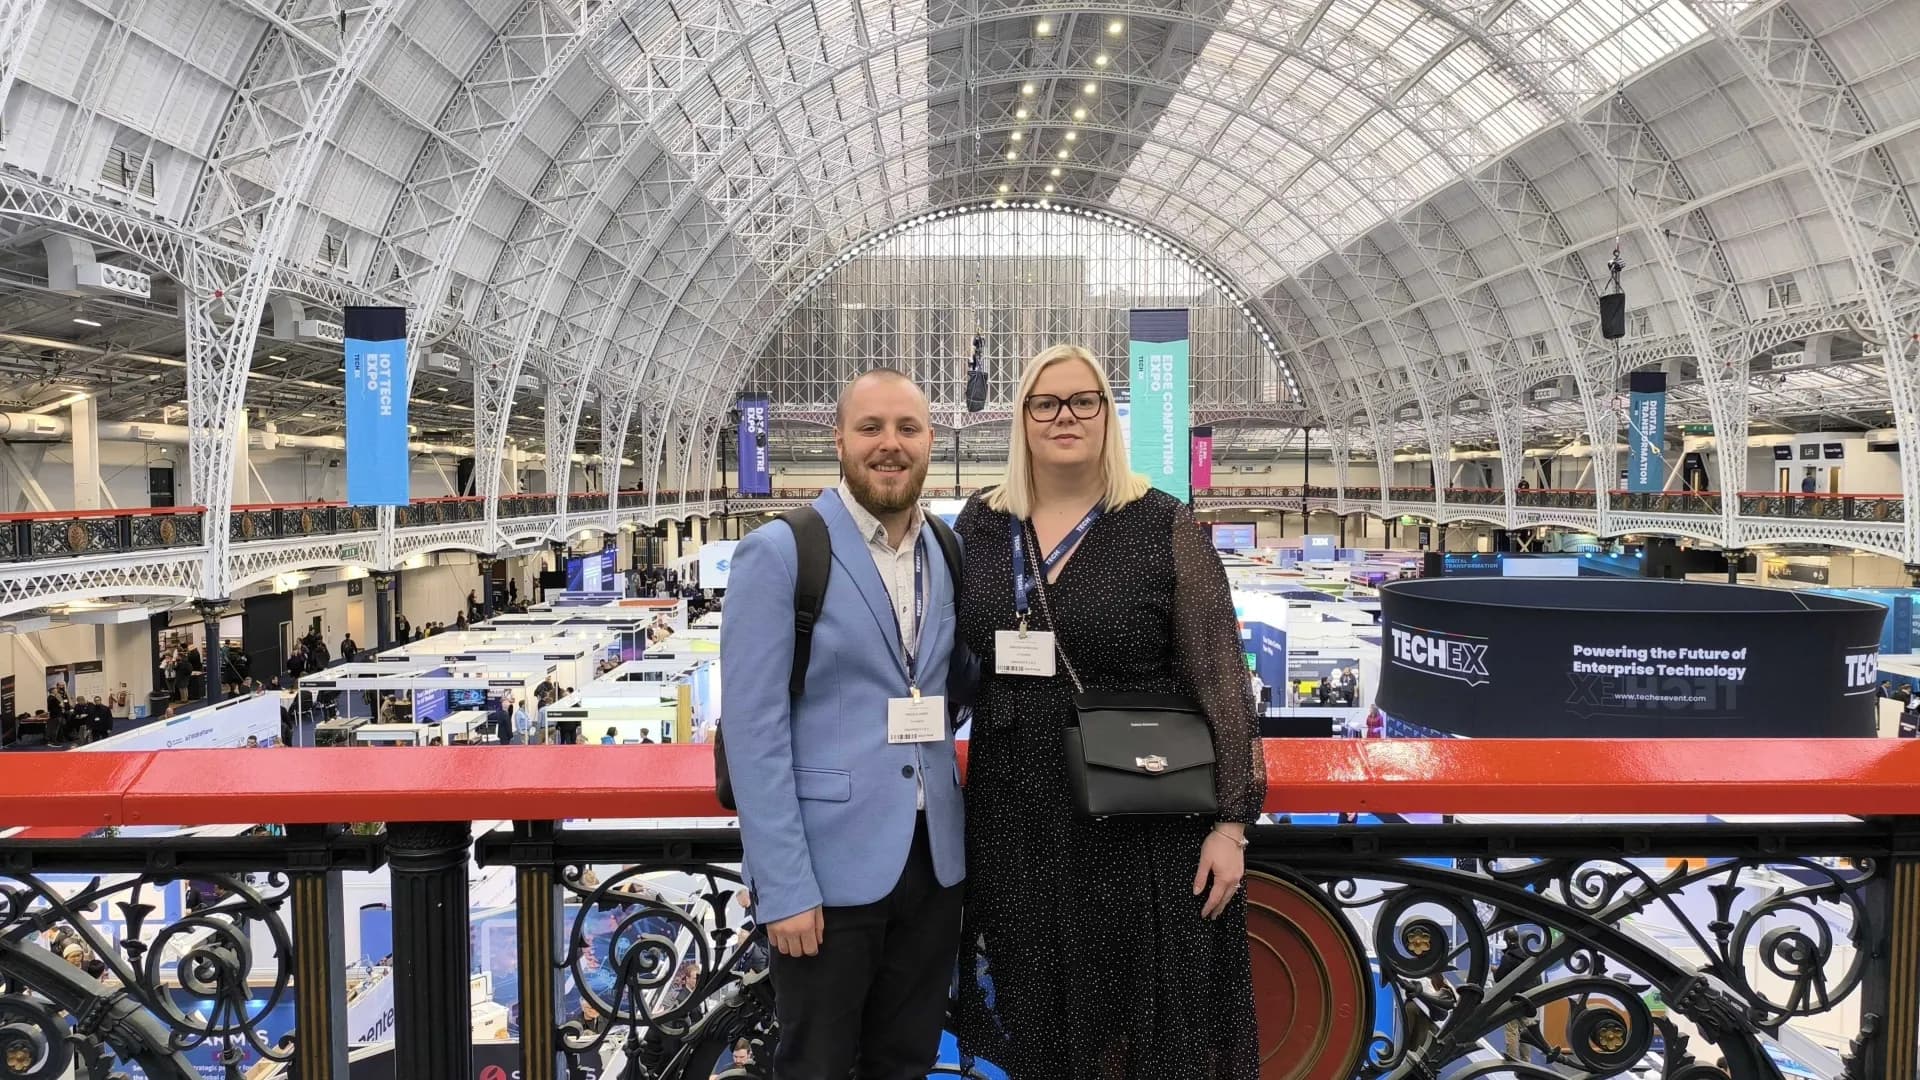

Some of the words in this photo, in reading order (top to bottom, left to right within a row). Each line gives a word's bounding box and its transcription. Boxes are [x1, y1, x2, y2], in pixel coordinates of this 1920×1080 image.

[367, 353, 378, 391] EXPO
[380, 354, 391, 377] IOT
[1150, 354, 1161, 392] EXPO
[1162, 354, 1173, 390] EDGE
[380, 379, 392, 416] TECH
[747, 407, 756, 433] EXPO
[1162, 391, 1174, 475] COMPUTING
[1649, 400, 1657, 435] DIGITAL
[1640, 401, 1649, 485] TRANSFORMATION
[1804, 448, 1814, 456] Lift
[1391, 627, 1489, 676] TECHEX
[1573, 645, 1648, 662] Powering
[1650, 647, 1677, 660] the
[1679, 647, 1730, 660] Future
[1731, 647, 1748, 660] of
[1573, 661, 1655, 678] Enterprise
[1656, 664, 1747, 681] Technology
[1614, 692, 1707, 703] www.techexevent.com
